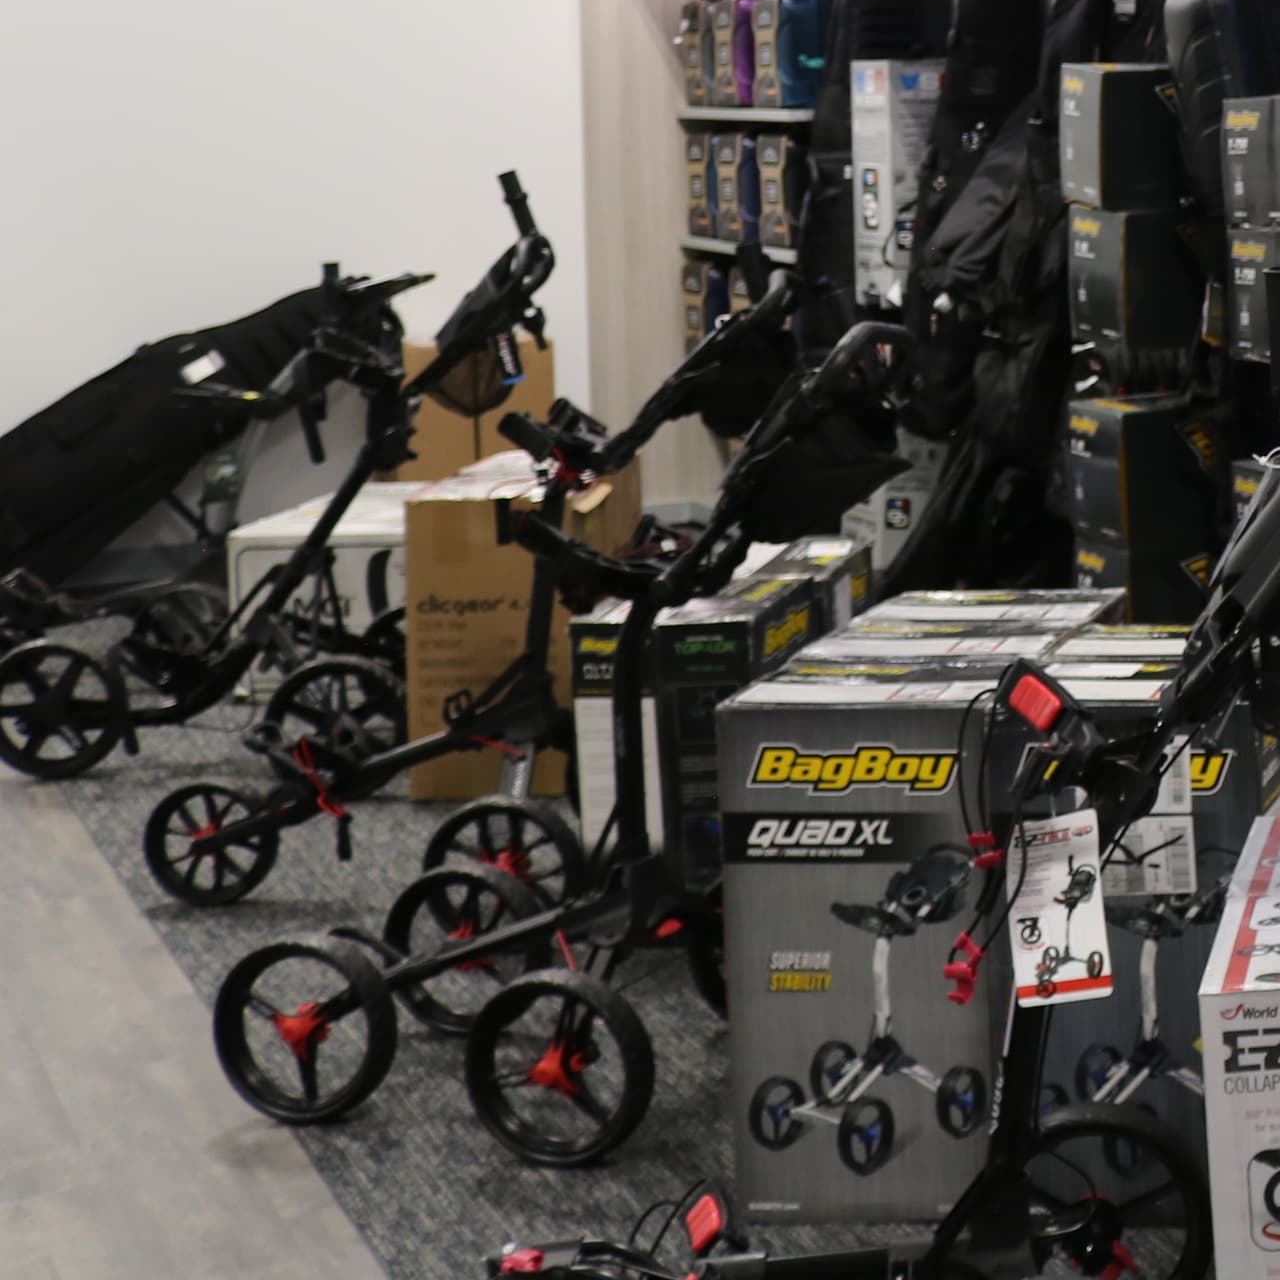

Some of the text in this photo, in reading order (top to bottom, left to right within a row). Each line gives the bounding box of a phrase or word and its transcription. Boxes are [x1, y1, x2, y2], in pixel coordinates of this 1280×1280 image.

[417, 594, 505, 615] clicgear
[755, 748, 954, 790] BagBoy
[854, 819, 893, 845] XL
[770, 951, 831, 970] SUPERIOR
[770, 972, 832, 991] STABILITY
[1242, 1006, 1277, 1020] World
